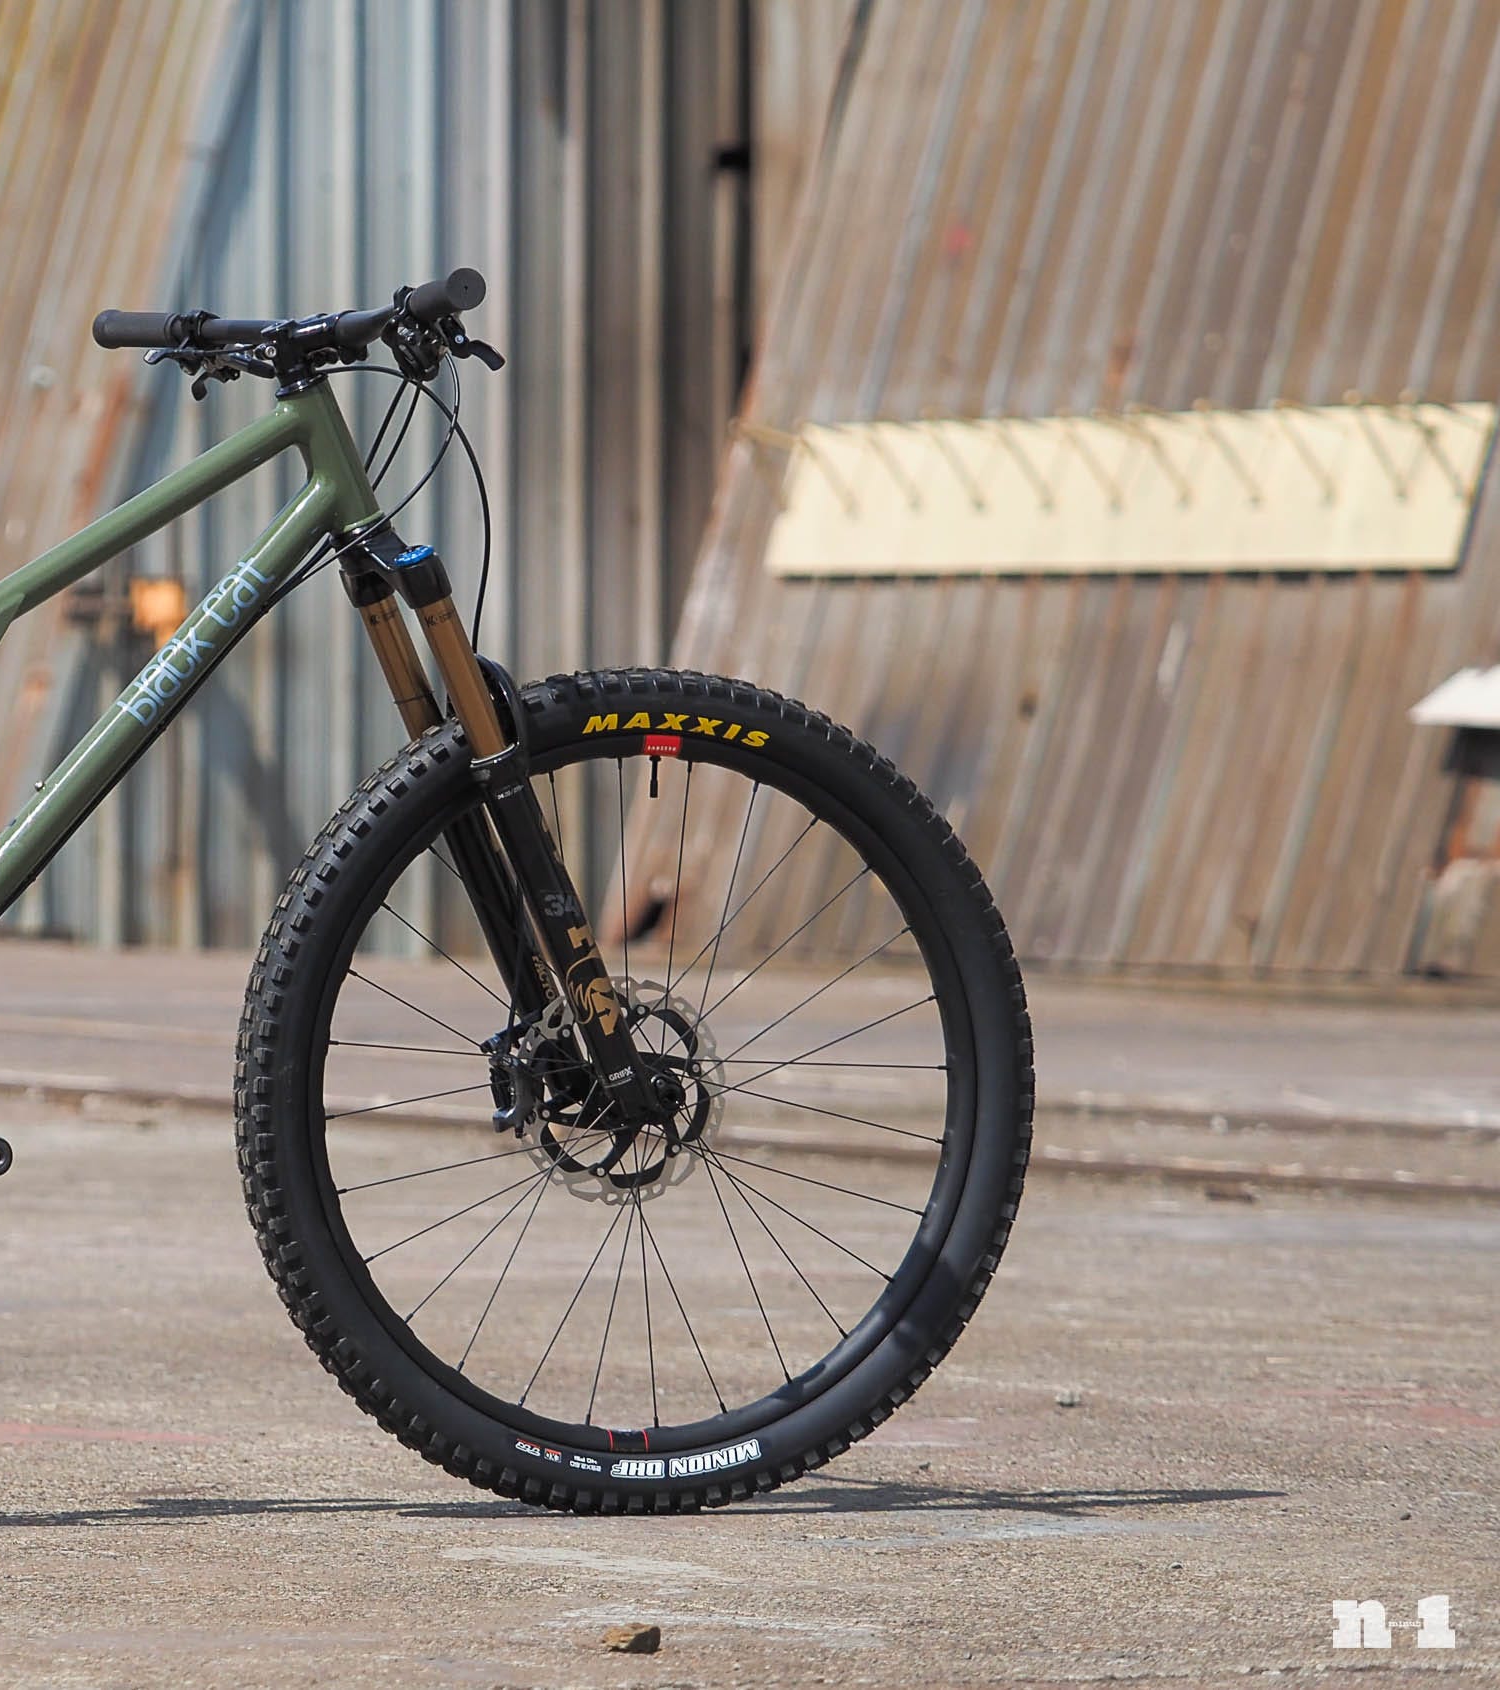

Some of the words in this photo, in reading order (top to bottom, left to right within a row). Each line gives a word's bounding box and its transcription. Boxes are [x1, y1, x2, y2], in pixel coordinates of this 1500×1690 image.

[116, 627, 215, 727] black
[202, 556, 276, 629] cat
[582, 712, 771, 748] MAXXIS
[611, 1459, 666, 1479] DHF
[669, 1439, 761, 1477] MINION
